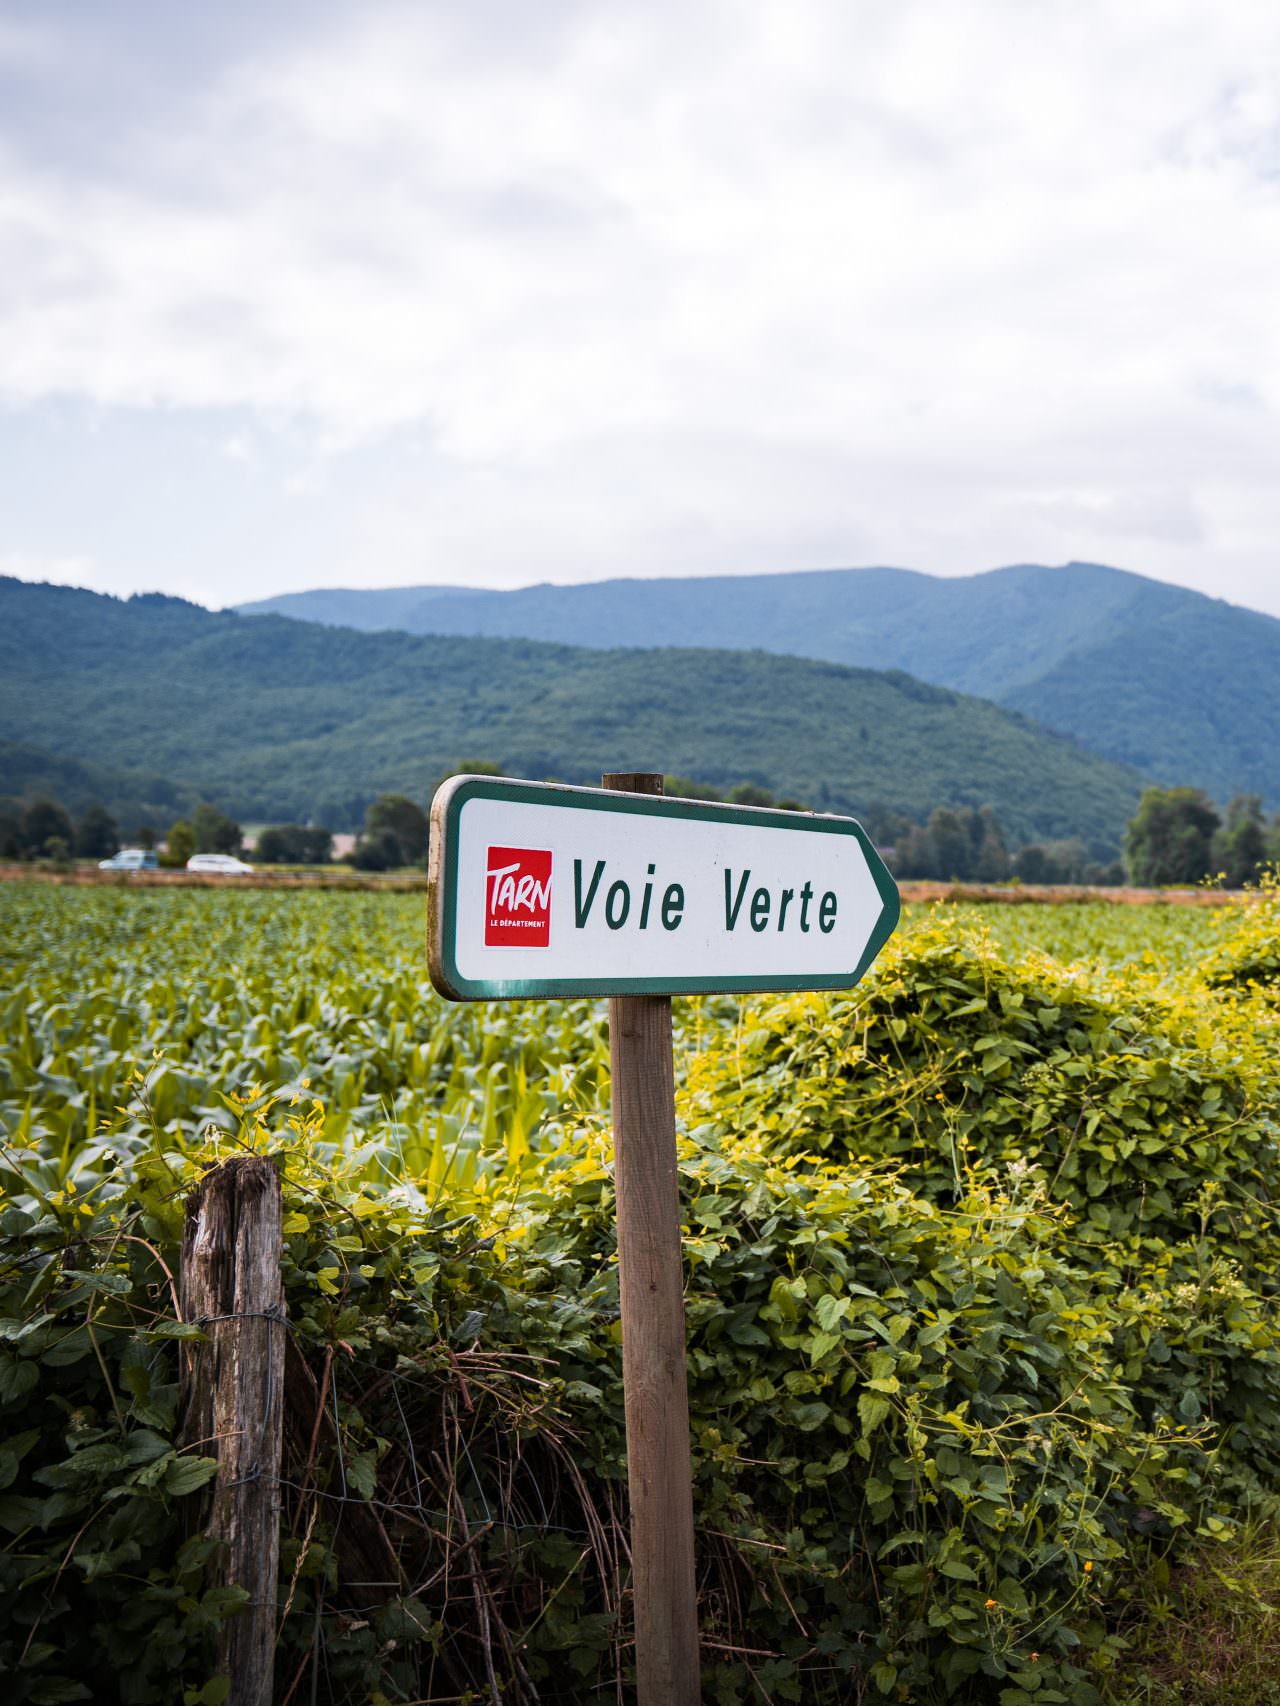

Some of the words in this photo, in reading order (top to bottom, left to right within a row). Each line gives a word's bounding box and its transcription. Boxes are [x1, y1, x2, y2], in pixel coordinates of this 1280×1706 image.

[486, 863, 552, 915] TARN
[573, 859, 685, 931] Voie
[724, 868, 838, 934] Verte
[500, 918, 545, 927] DÉPARTEMENT
